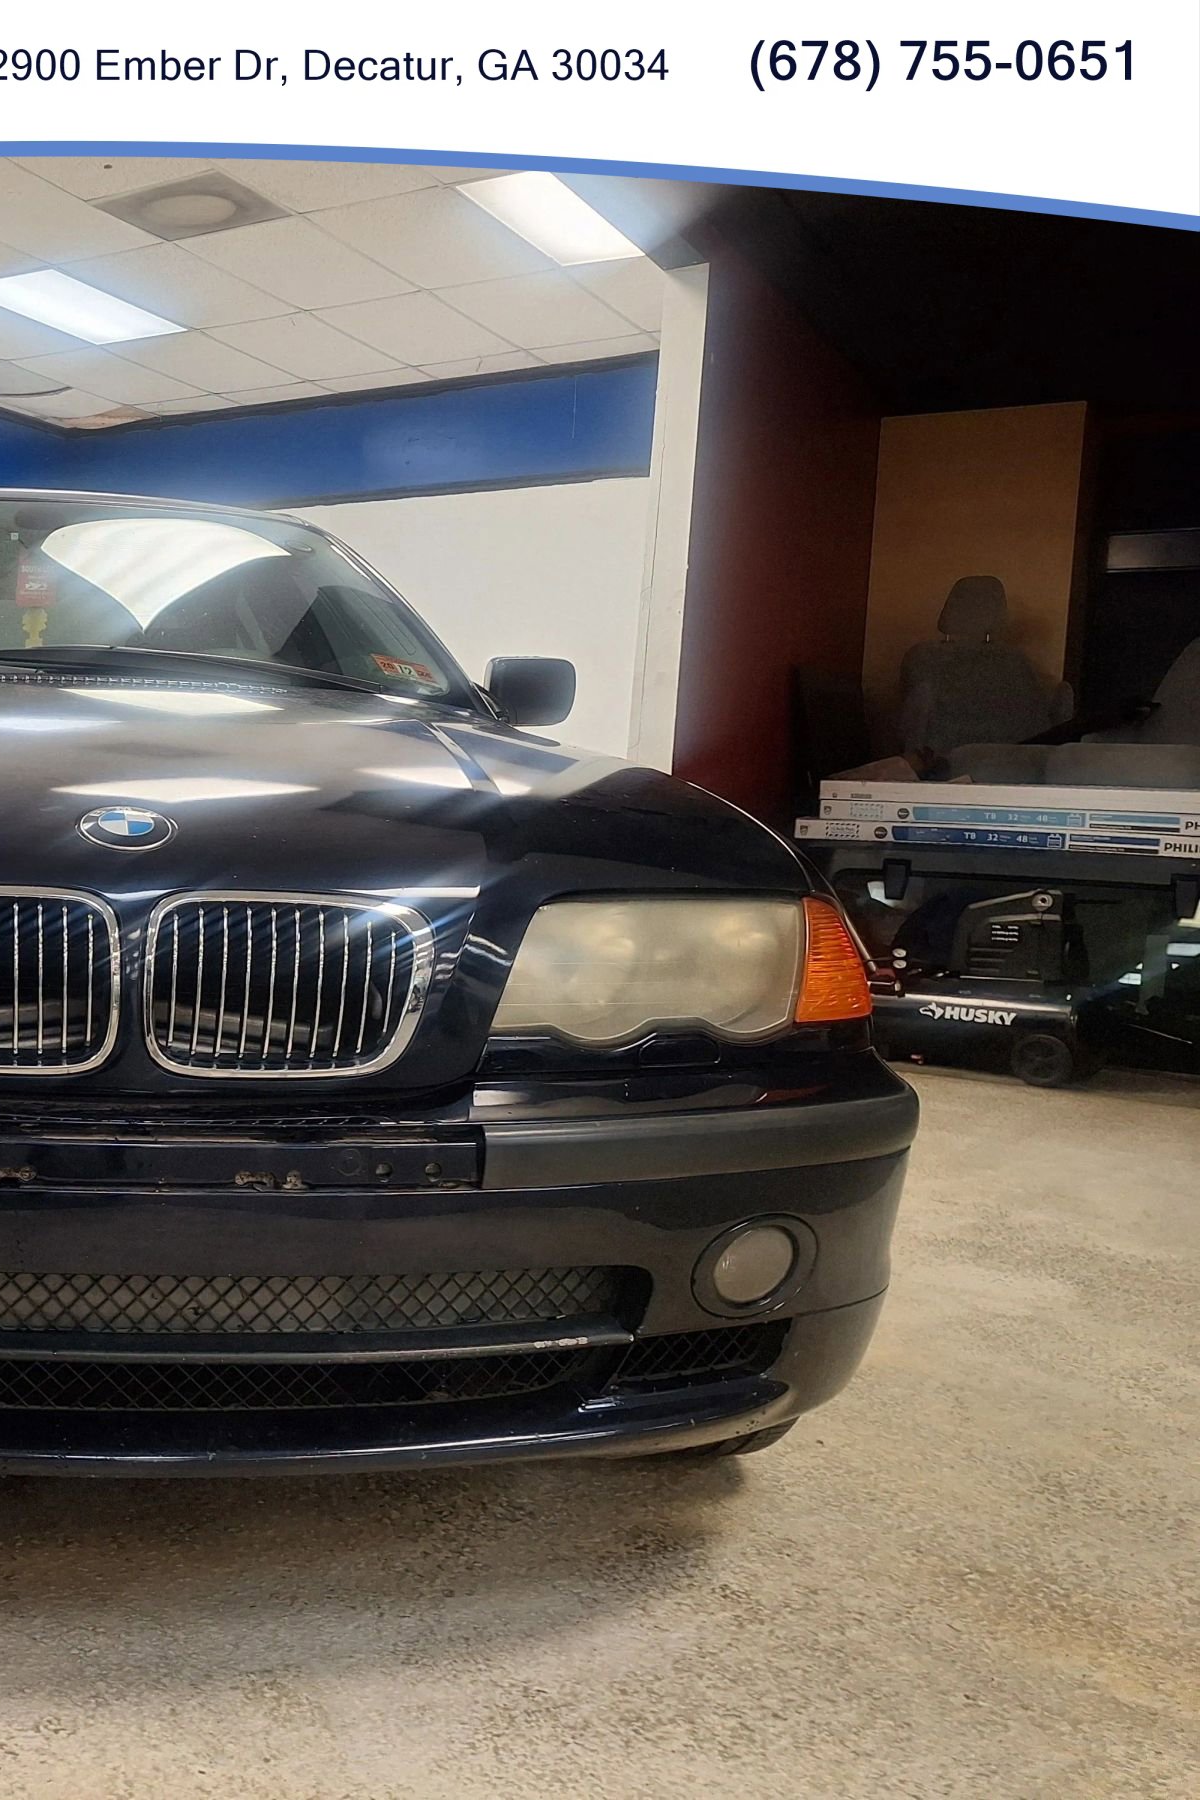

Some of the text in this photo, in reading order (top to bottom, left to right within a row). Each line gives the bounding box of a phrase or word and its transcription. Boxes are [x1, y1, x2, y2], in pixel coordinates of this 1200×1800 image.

[963, 831, 976, 840] T8
[987, 833, 999, 842] 32
[1016, 835, 1028, 843] 48
[944, 1006, 1017, 1026] HUSKY
